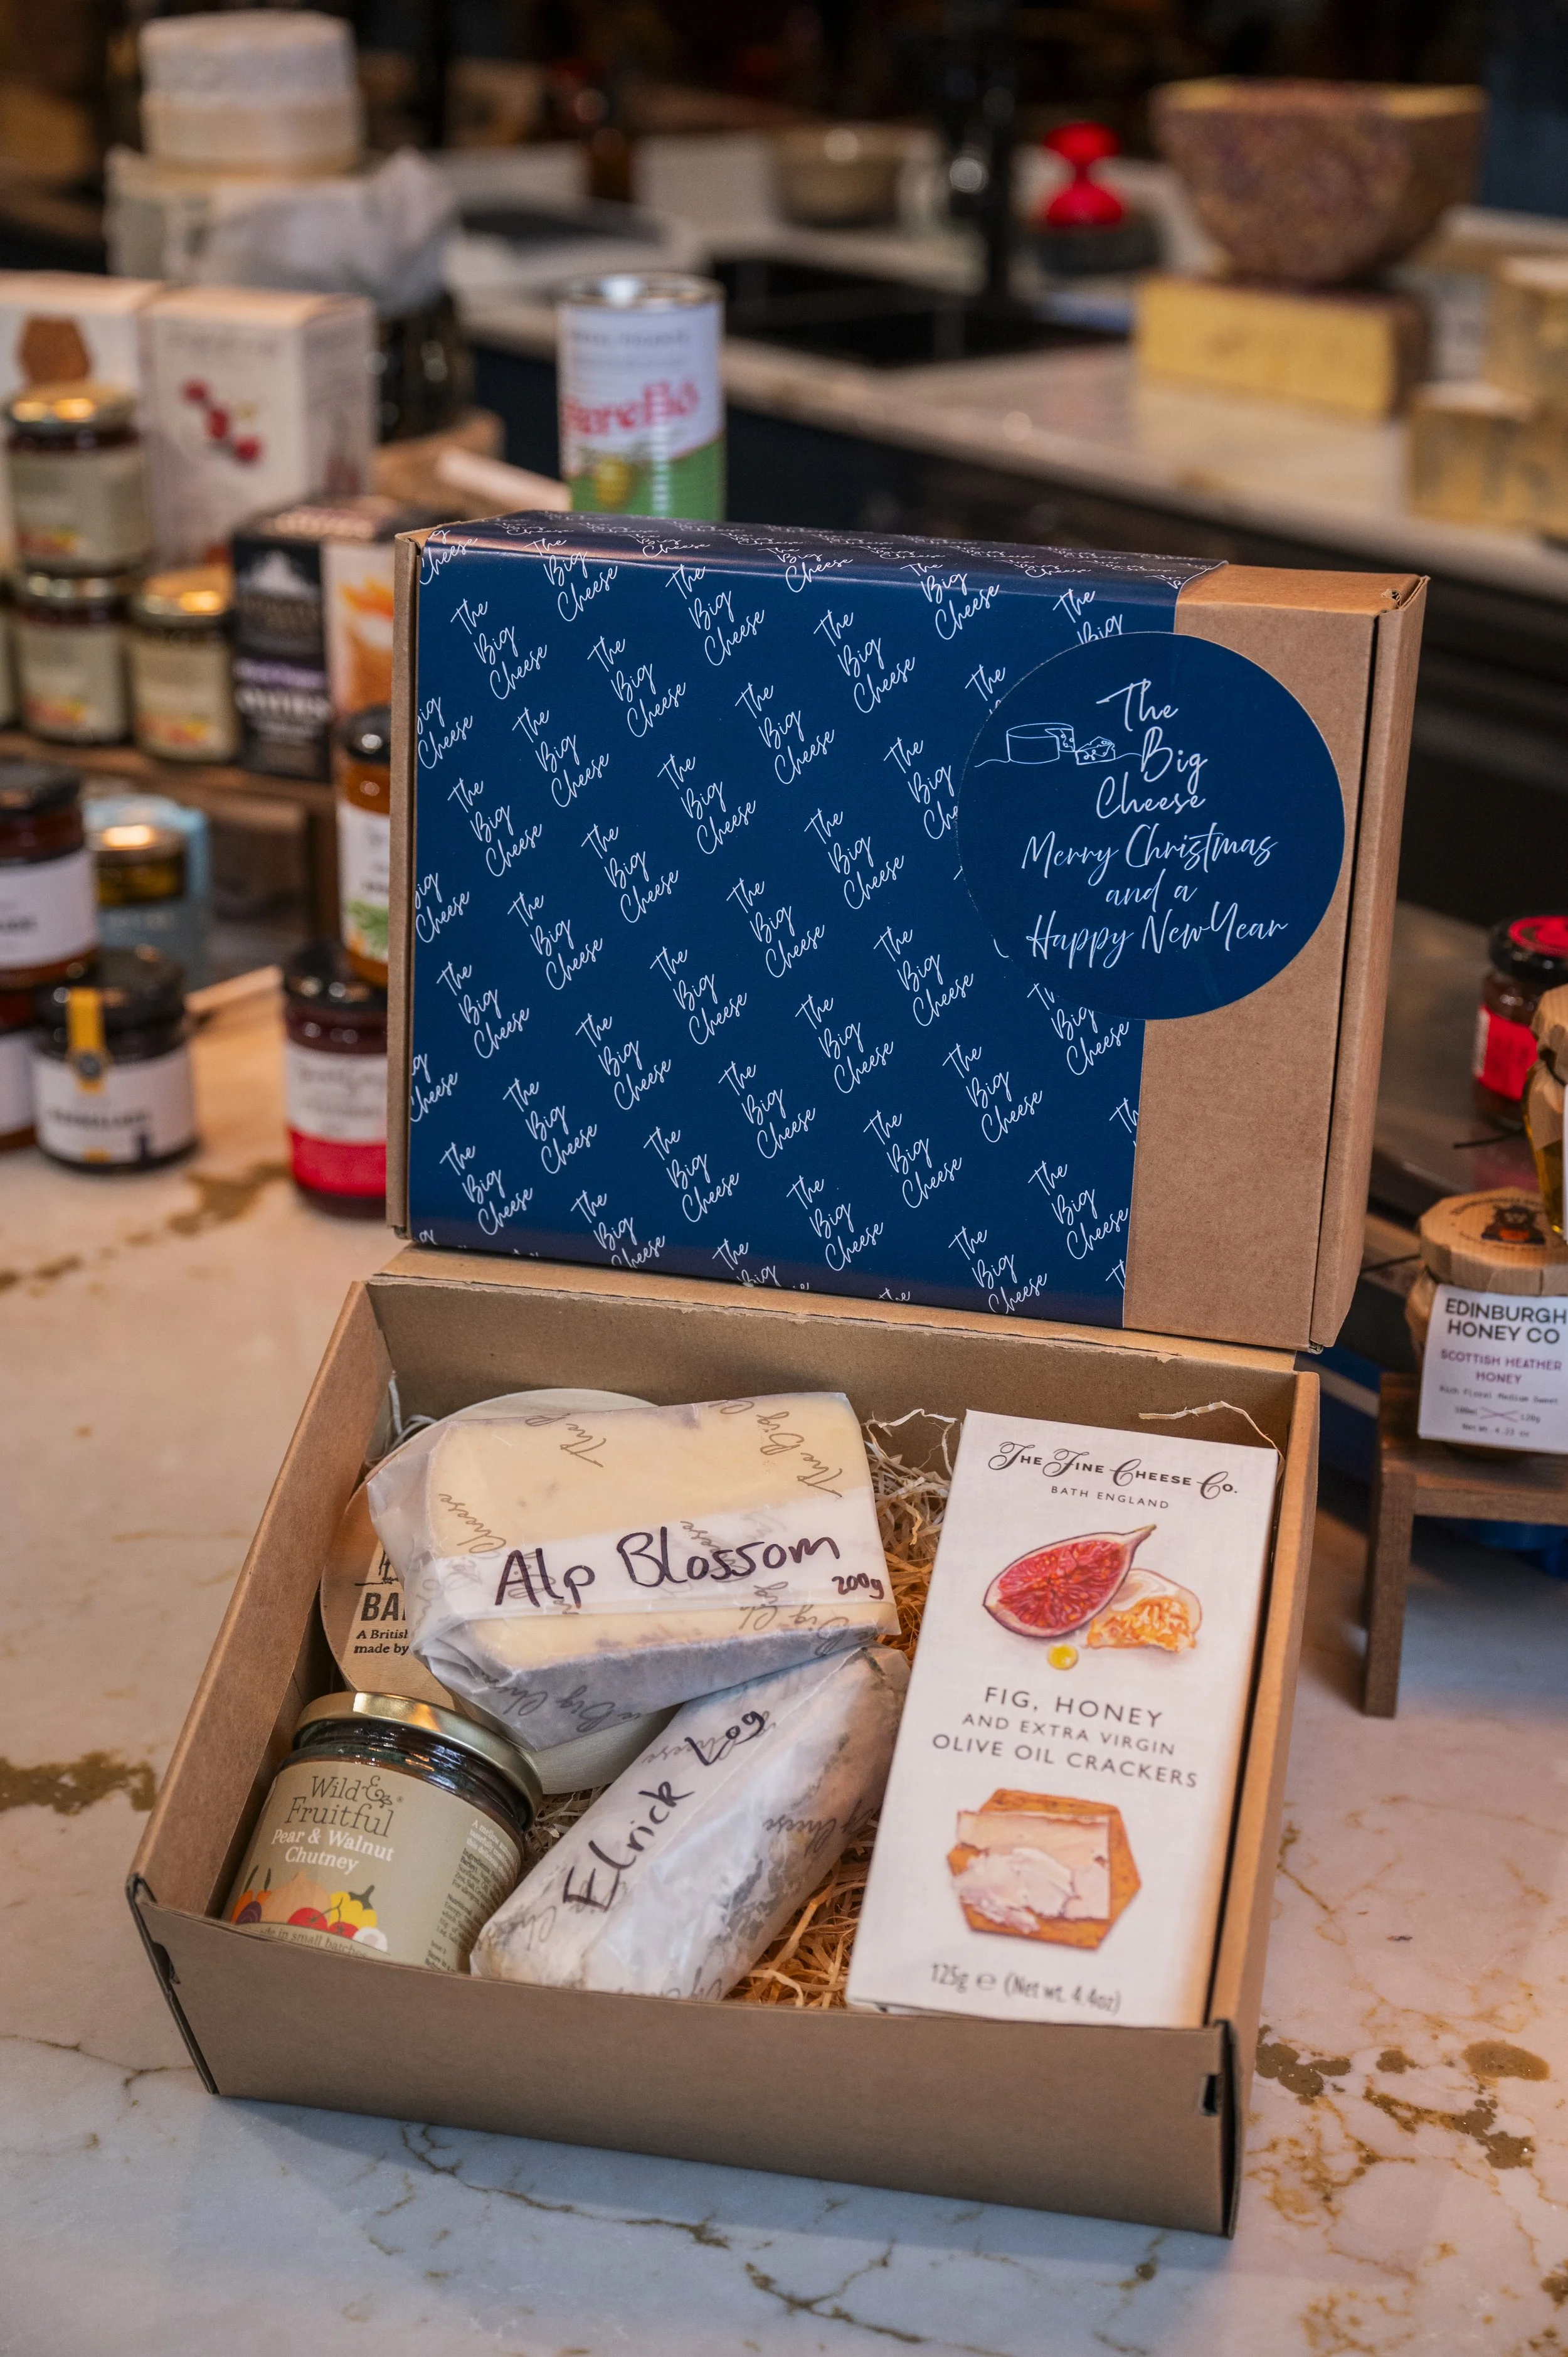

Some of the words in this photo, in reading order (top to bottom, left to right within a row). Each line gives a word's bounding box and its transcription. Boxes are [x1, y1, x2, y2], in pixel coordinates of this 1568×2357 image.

[665, 563, 706, 600] The
[450, 598, 488, 635] The
[688, 590, 734, 631] Big
[813, 609, 854, 647] The
[473, 625, 519, 666] Big
[586, 635, 625, 673] The
[704, 609, 765, 666] Cheese
[489, 644, 548, 700] Cheese
[837, 637, 885, 678] Big
[610, 663, 657, 703] Big
[734, 682, 774, 719] The
[854, 656, 916, 713] Cheese
[627, 682, 686, 738] Cheese
[1096, 679, 1178, 731] The
[511, 706, 549, 743] The
[758, 710, 805, 750] Big
[534, 734, 580, 774] Big
[657, 753, 696, 790] The
[774, 729, 835, 785] Cheese
[1141, 726, 1207, 795] Big
[447, 777, 484, 813] The
[551, 753, 609, 808] Cheese
[1096, 772, 1205, 819] Cheese
[680, 781, 727, 821] Big
[469, 805, 514, 843] Big
[580, 823, 619, 859] The
[696, 800, 756, 854] Cheese
[803, 807, 844, 844] The
[485, 823, 543, 877] Cheese
[827, 836, 874, 875] Big
[1021, 831, 1119, 885] Merry
[1125, 823, 1278, 872] Christmas
[603, 851, 650, 890] Big
[844, 855, 904, 910] Cheese
[507, 891, 544, 927] The
[620, 870, 679, 923] Cheese
[726, 877, 765, 914] The
[1106, 869, 1166, 912] and
[1174, 885, 1197, 901] a
[529, 918, 575, 957] Big
[749, 905, 795, 944] Big
[873, 925, 913, 962] The
[1026, 911, 1134, 969] Happy
[546, 937, 603, 991] Cheese
[649, 945, 688, 982] The
[765, 924, 825, 978] Cheese
[436, 960, 472, 996] The
[672, 973, 718, 1011] Big
[896, 954, 943, 992] Big
[458, 989, 502, 1026] Big
[689, 992, 748, 1045] Cheese
[795, 994, 834, 1030] The
[913, 973, 974, 1027] Cheese
[474, 1008, 529, 1059] Cheese
[575, 1013, 613, 1048] The
[818, 1022, 864, 1060] Big
[598, 1040, 643, 1077] Big
[834, 1041, 894, 1093] Cheese
[941, 1043, 982, 1079] The
[502, 1077, 539, 1112] The
[613, 1059, 671, 1110] Cheese
[718, 1060, 756, 1096] The
[965, 1071, 1012, 1109] Big
[525, 1105, 569, 1142] Big
[741, 1088, 787, 1126] Big
[981, 1090, 1042, 1143] Cheese
[643, 1125, 681, 1161] The
[756, 1107, 816, 1159] Cheese
[863, 1109, 903, 1146] The
[439, 1142, 476, 1176] The
[541, 1124, 598, 1174] Cheese
[886, 1137, 933, 1175] Big
[462, 1169, 506, 1205] Big
[665, 1153, 711, 1190] Big
[902, 1157, 962, 1208] Cheese
[1027, 1160, 1068, 1196] The
[478, 1187, 533, 1235] Cheese
[682, 1172, 739, 1223] Cheese
[786, 1174, 825, 1210] The
[1051, 1188, 1098, 1226] Big
[808, 1203, 854, 1239] Big
[1066, 1208, 1128, 1260] Cheese
[825, 1221, 884, 1272] Cheese
[1446, 1297, 1567, 1324] EDINBURGH
[1448, 1319, 1521, 1341] HONEY
[1527, 1328, 1560, 1344] CO
[1441, 1348, 1500, 1366] SCOTTISH
[1505, 1356, 1562, 1371] HEATHER
[1476, 1371, 1522, 1385] HONEY
[1051, 1486, 1088, 1498] BATH
[1097, 1492, 1168, 1509] ENGLAND
[438, 1492, 507, 1555] Cheese
[495, 1546, 595, 1610] Alp
[616, 1526, 841, 1588] Blossom
[832, 1574, 885, 1600] 200g
[361, 1592, 406, 1621] BA
[353, 1644, 390, 1654] made
[394, 1643, 409, 1656] by
[356, 1630, 366, 1639] A
[985, 1686, 1038, 1711] FIG,
[1055, 1696, 1162, 1728] HONEY
[684, 1710, 770, 1767] Log
[962, 1713, 1009, 1730] AND
[1020, 1720, 1089, 1742] EXTRA
[1101, 1732, 1175, 1756] VIRGIN
[933, 1733, 1003, 1757] OLIVE
[1015, 1744, 1054, 1764] OIL
[1066, 1752, 1198, 1788] CRACKERS
[312, 1775, 361, 1802] Wild
[284, 1796, 395, 1838] Fruitful
[271, 1829, 305, 1845] Pear
[307, 1827, 322, 1844] &
[329, 1829, 395, 1861] Walnut
[285, 1846, 359, 1875] Chutney
[290, 1933, 322, 1947] small
[931, 1962, 968, 1994] 125g
